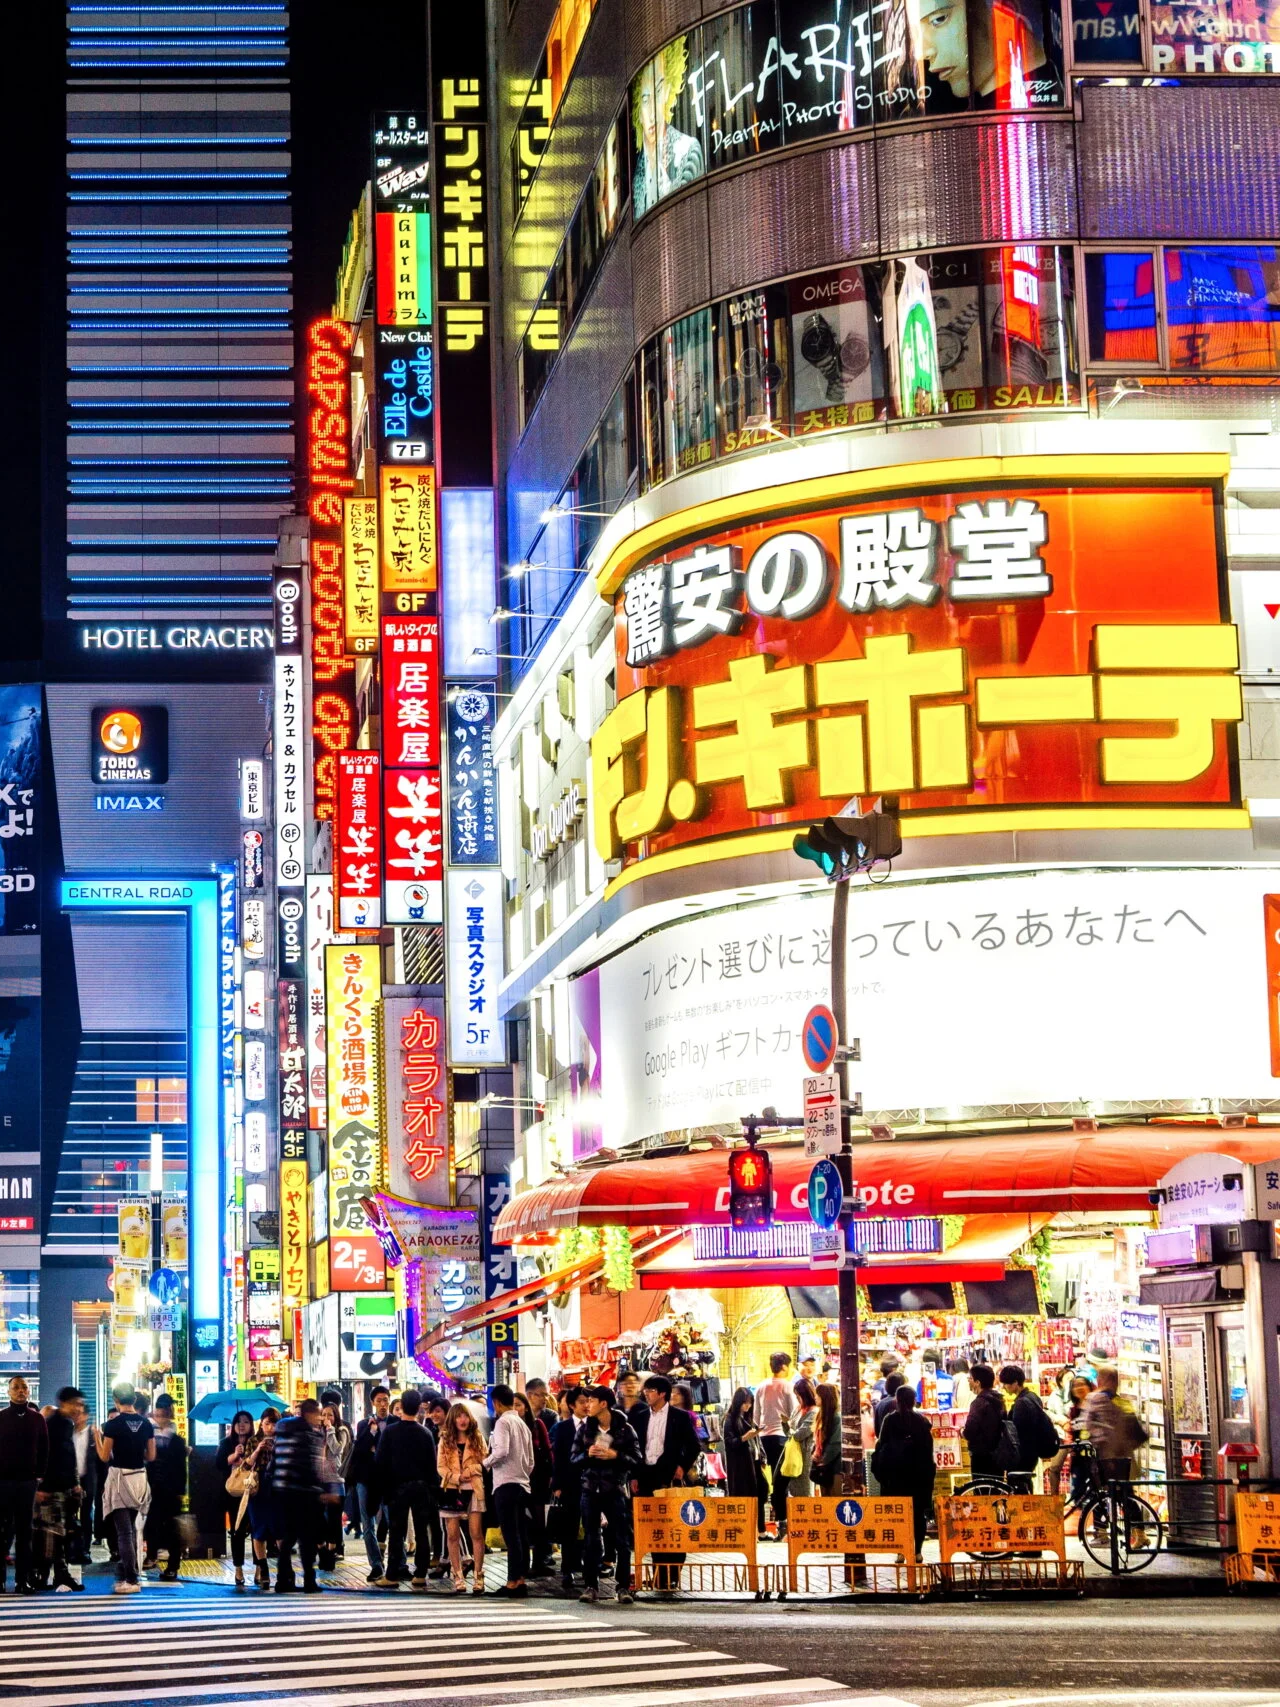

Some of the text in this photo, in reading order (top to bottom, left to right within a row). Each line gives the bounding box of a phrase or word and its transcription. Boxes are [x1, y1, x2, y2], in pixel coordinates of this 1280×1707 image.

[803, 279, 864, 301] OMEGA
[380, 332, 405, 343] New
[410, 346, 432, 417] Castle
[385, 359, 407, 437] Elle de
[994, 387, 1073, 408] SALE
[803, 402, 875, 431] 大特価
[397, 445, 422, 457] 7F
[624, 499, 1052, 667] 驚安の殿堂
[397, 593, 426, 611] 6F
[83, 628, 275, 648] HOTEL GRACERY
[355, 638, 375, 650] 6F
[393, 639, 433, 652] 居酒屋
[397, 662, 431, 763] 居楽屋
[100, 757, 137, 769] TOHO
[100, 769, 151, 780] CINEMAS
[96, 796, 162, 810] IMAX
[248, 772, 258, 813] 東京ビル
[351, 778, 368, 824] 居楽屋
[69, 886, 194, 899] CENTRAL ROAD
[467, 907, 488, 1012] 写真スタジオ
[342, 953, 365, 1086] きんくら酒場
[466, 1023, 491, 1044] 5F
[645, 1039, 709, 1077] Google Play
[280, 1045, 307, 1120] 甘太郎
[402, 1009, 443, 1181] カラオケ
[284, 1129, 305, 1143] 4F
[284, 1144, 305, 1157] 3F
[332, 1120, 376, 1230] 金の蔵
[814, 1177, 828, 1219] P
[825, 1199, 834, 1217] 40
[937, 1452, 955, 1467] 880
[652, 1529, 737, 1542] 歩行者専用
[808, 1529, 895, 1542] 歩行者専用
